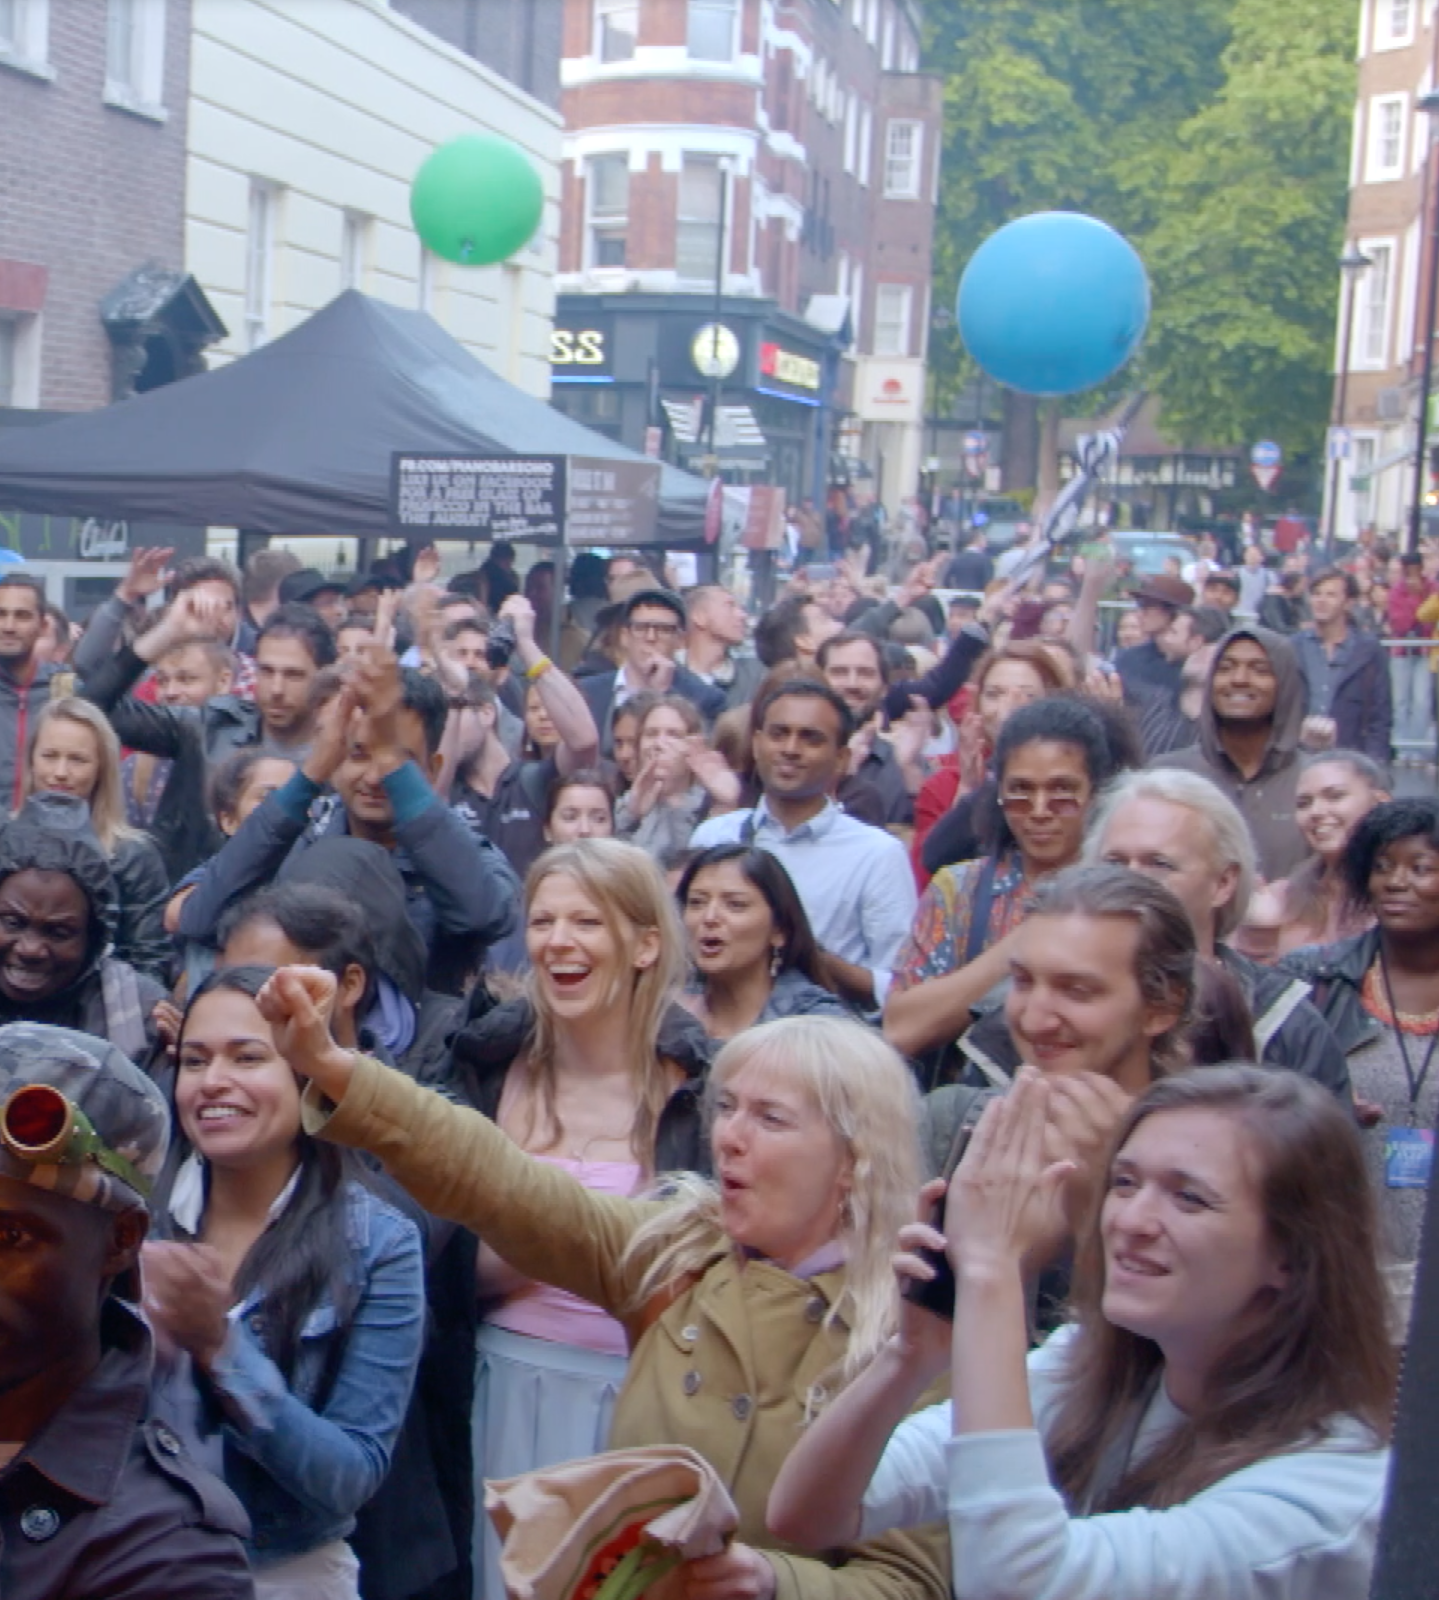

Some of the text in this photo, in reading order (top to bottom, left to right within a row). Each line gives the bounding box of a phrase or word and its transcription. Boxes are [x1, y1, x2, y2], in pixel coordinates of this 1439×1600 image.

[400, 474, 428, 485] LIKE
[452, 475, 476, 485] ON
[479, 476, 553, 489] FACEBOOK
[399, 487, 427, 499] FOR
[495, 502, 521, 514] THE
[524, 502, 554, 515] BAR
[433, 514, 489, 526] AUGUST
